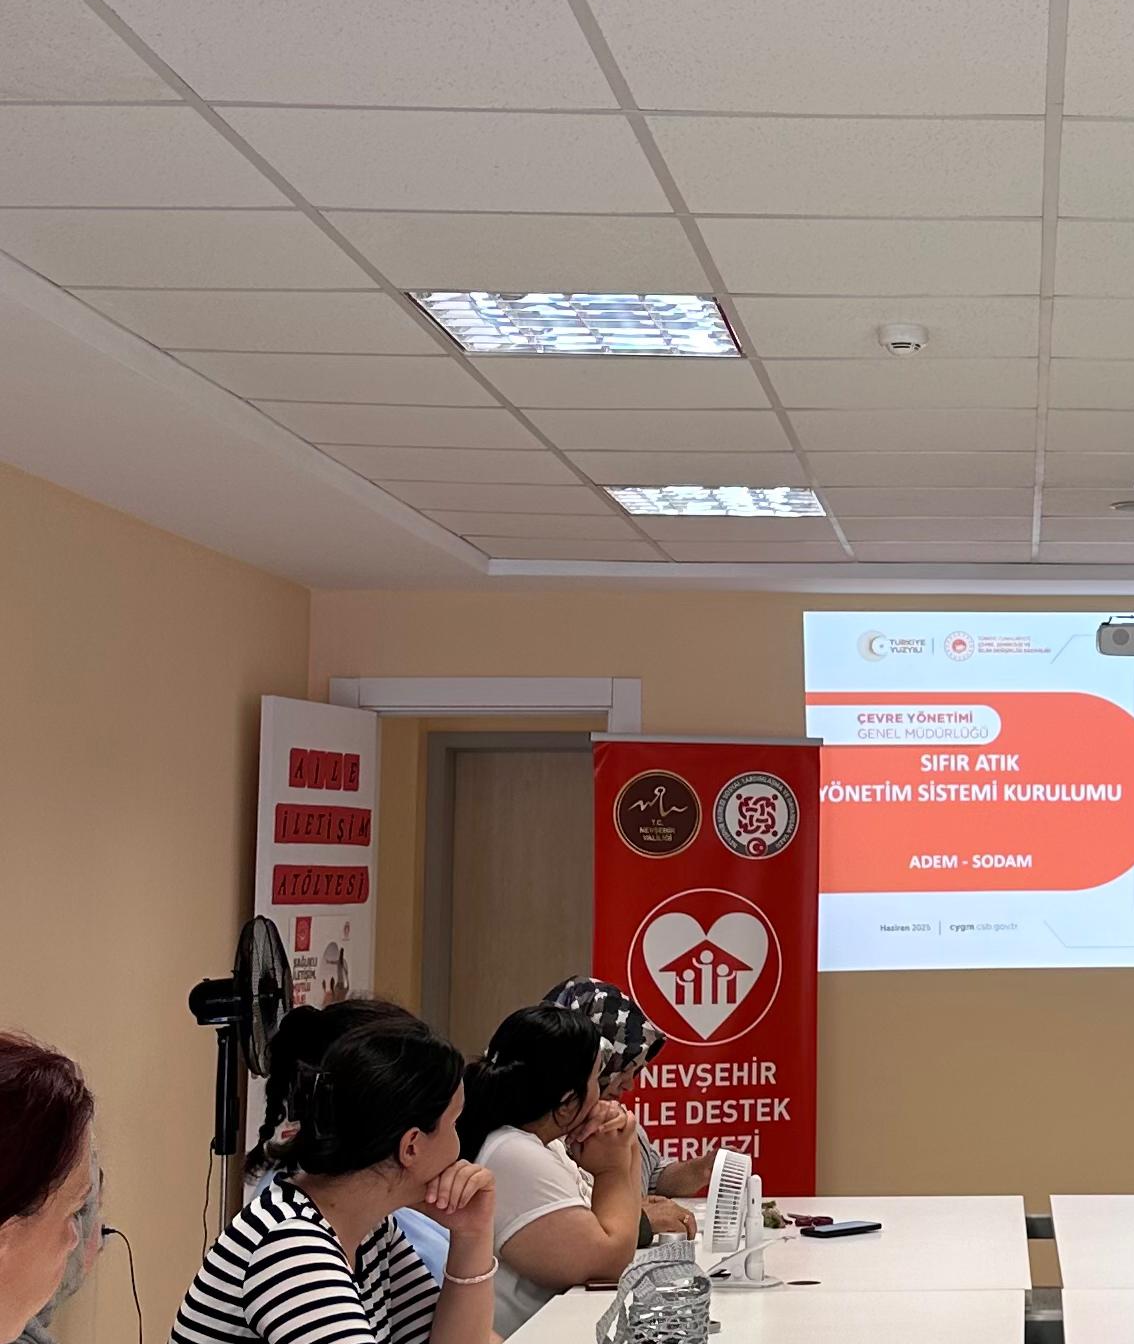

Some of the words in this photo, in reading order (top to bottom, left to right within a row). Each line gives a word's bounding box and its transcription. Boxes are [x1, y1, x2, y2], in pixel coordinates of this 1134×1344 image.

[857, 713, 903, 725] ÇEVRE
[907, 711, 973, 724] YÖNETİMİ
[857, 728, 900, 739] GENEL
[905, 726, 989, 739] MÜDÜRLÜĞÜ
[294, 758, 357, 784] AİLE
[920, 754, 969, 772] SIFIR
[975, 754, 1020, 772] ATIK
[819, 780, 912, 803] YÖNETİM
[917, 780, 997, 802] SİSTEMİ
[1003, 783, 1122, 802] KURULUMU
[281, 810, 371, 843] İLETİŞİM
[909, 855, 958, 869] ADEM
[972, 854, 1033, 868] SODAM
[277, 869, 364, 899] ATÖLYESİ
[639, 1057, 777, 1093] NEVŞEHİR
[621, 1097, 677, 1127] İLE
[685, 1097, 791, 1125] DESTEK
